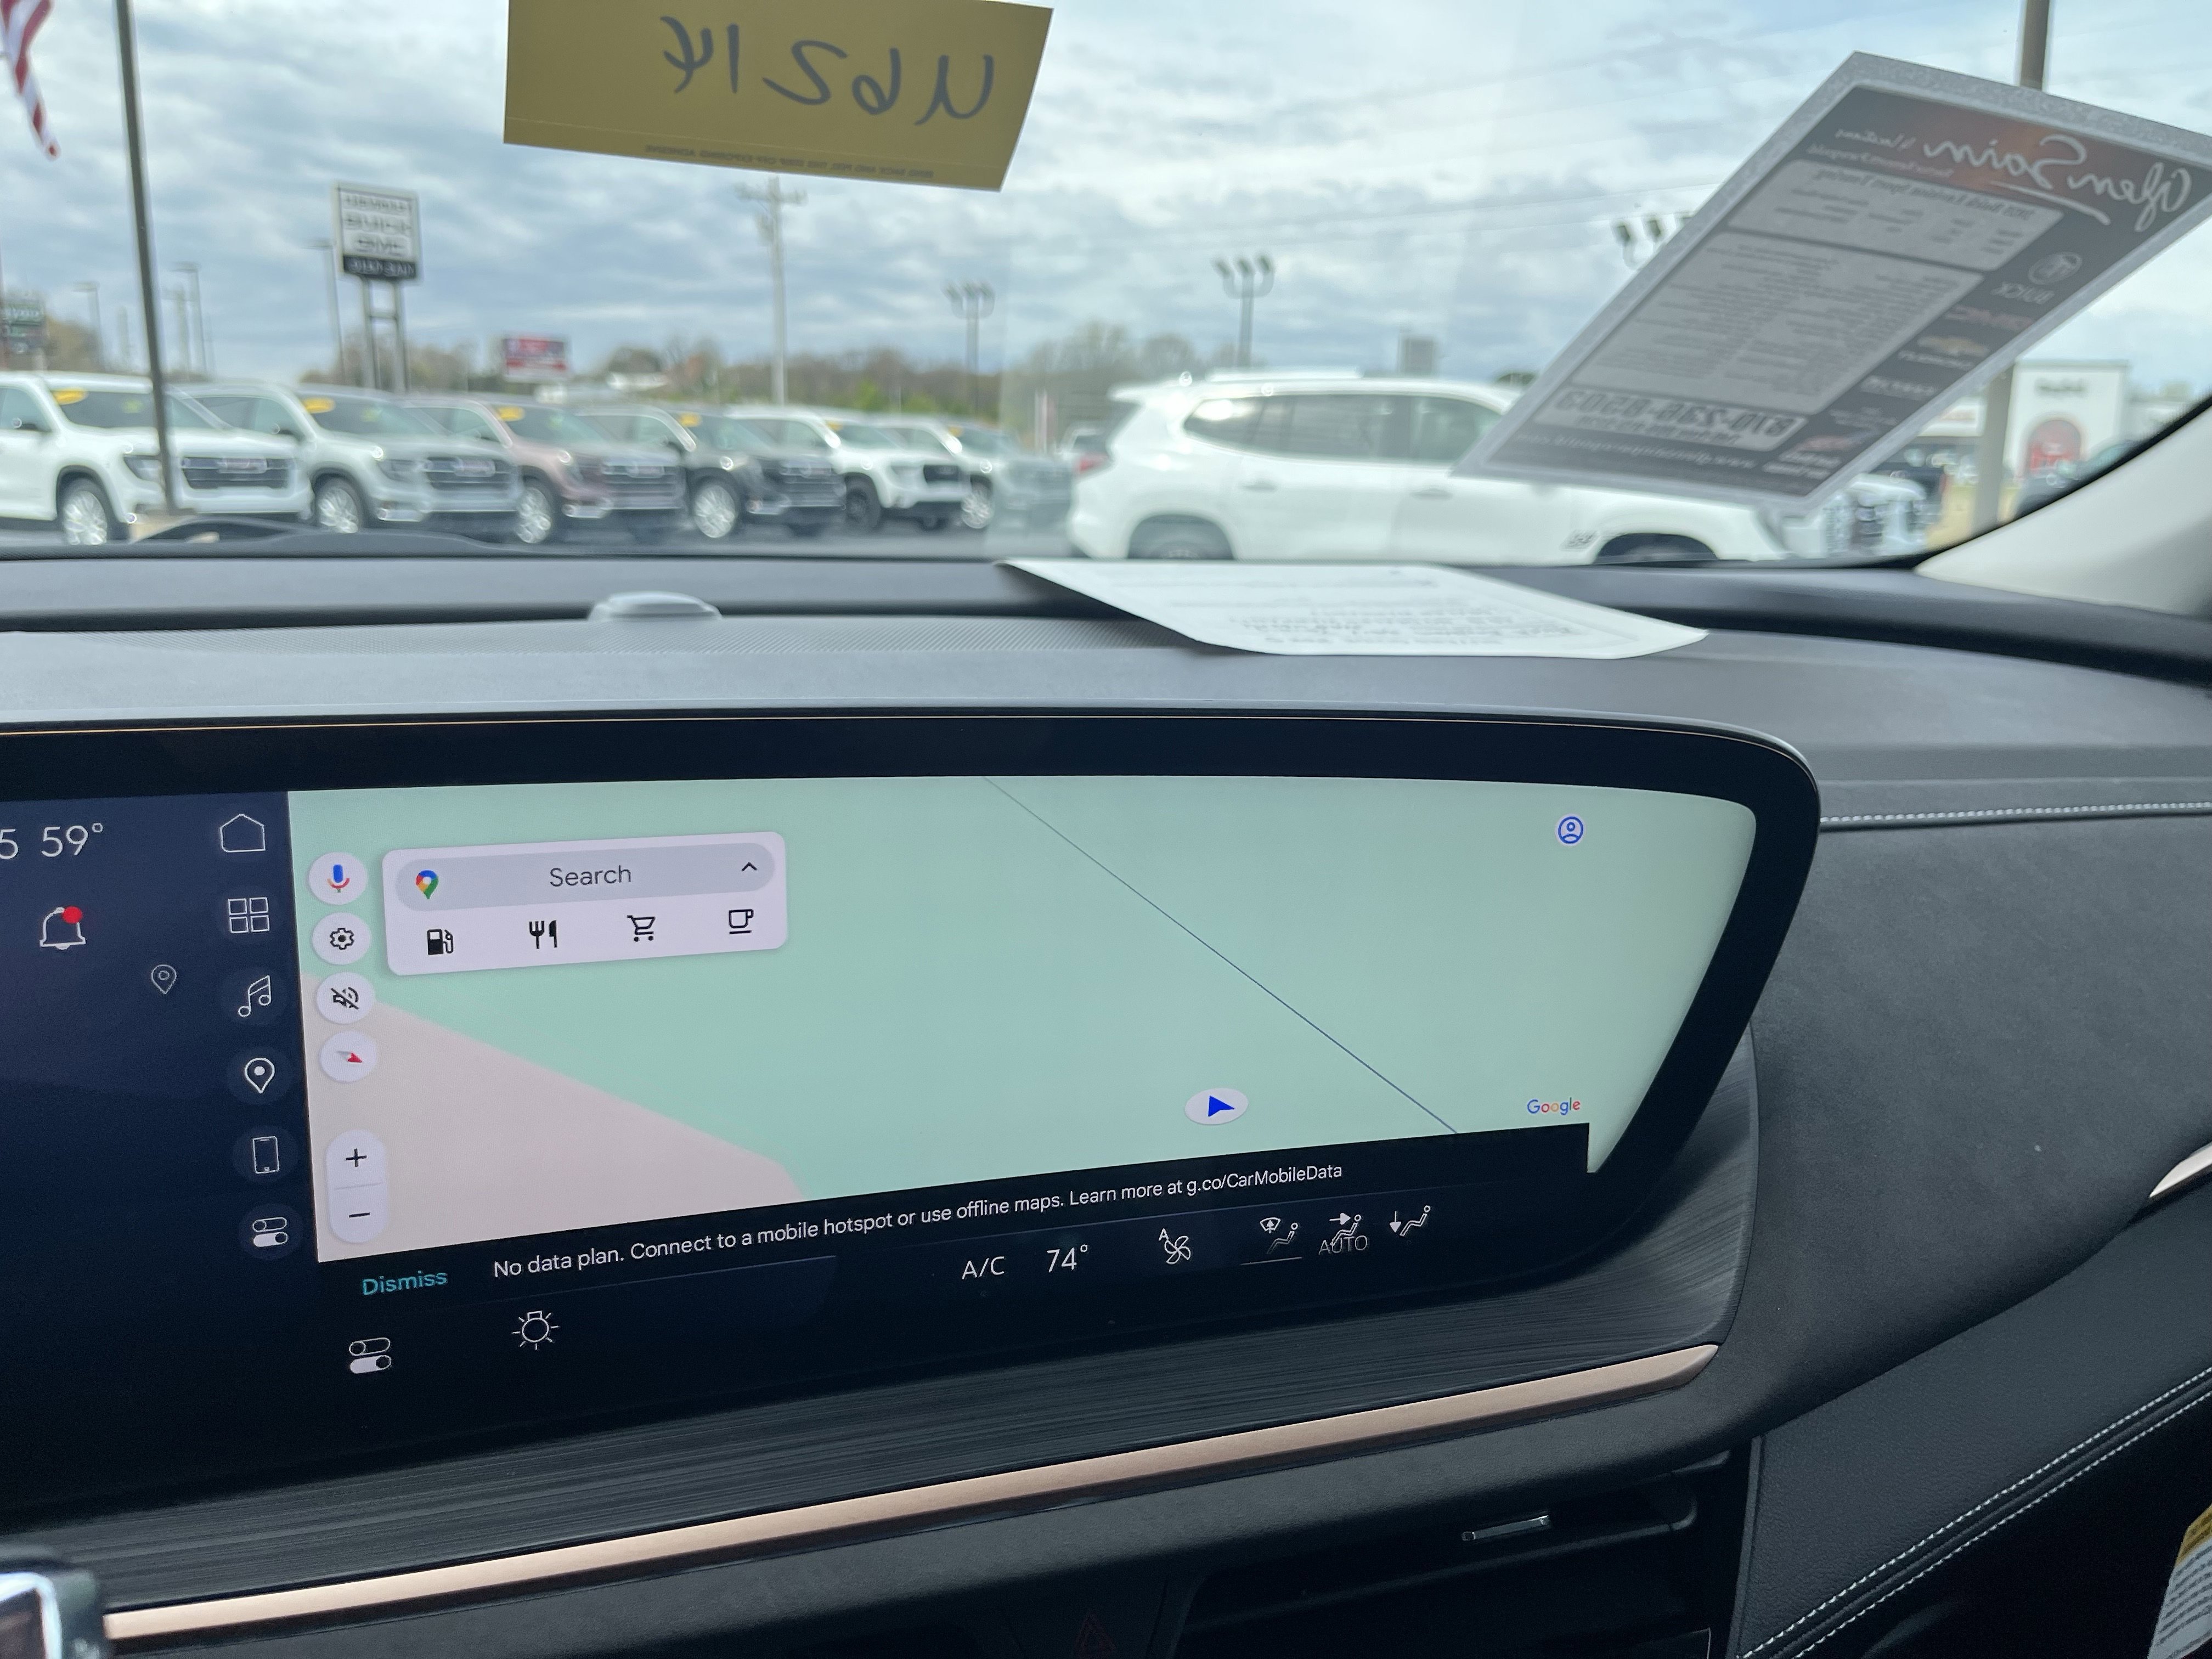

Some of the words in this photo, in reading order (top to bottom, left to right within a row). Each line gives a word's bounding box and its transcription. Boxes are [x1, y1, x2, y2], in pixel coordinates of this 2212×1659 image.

[42, 823, 103, 857] 59°
[550, 865, 631, 887] Search
[1527, 1097, 1580, 1115] Google
[494, 1261, 521, 1277] No
[528, 1255, 572, 1273] data
[578, 1248, 624, 1270] plan.
[631, 1235, 711, 1259] Connect
[716, 1234, 736, 1248] to
[742, 1233, 752, 1245] a
[758, 1222, 818, 1243] mobile
[824, 1213, 893, 1235] hotspot
[898, 1212, 916, 1226] or
[922, 1209, 951, 1222] use
[957, 1200, 1009, 1218] offline
[1015, 1196, 1063, 1212] maps.
[1070, 1190, 1116, 1205] Learn
[1122, 1185, 1162, 1199] more
[1167, 1180, 1182, 1194] at
[1187, 1165, 1341, 1196] g.co/CarMobileData
[1318, 1235, 1368, 1255] AUTO
[962, 1256, 1004, 1279] A/C
[1047, 1244, 1088, 1272] 74°
[363, 1271, 448, 1295] Dismiss
